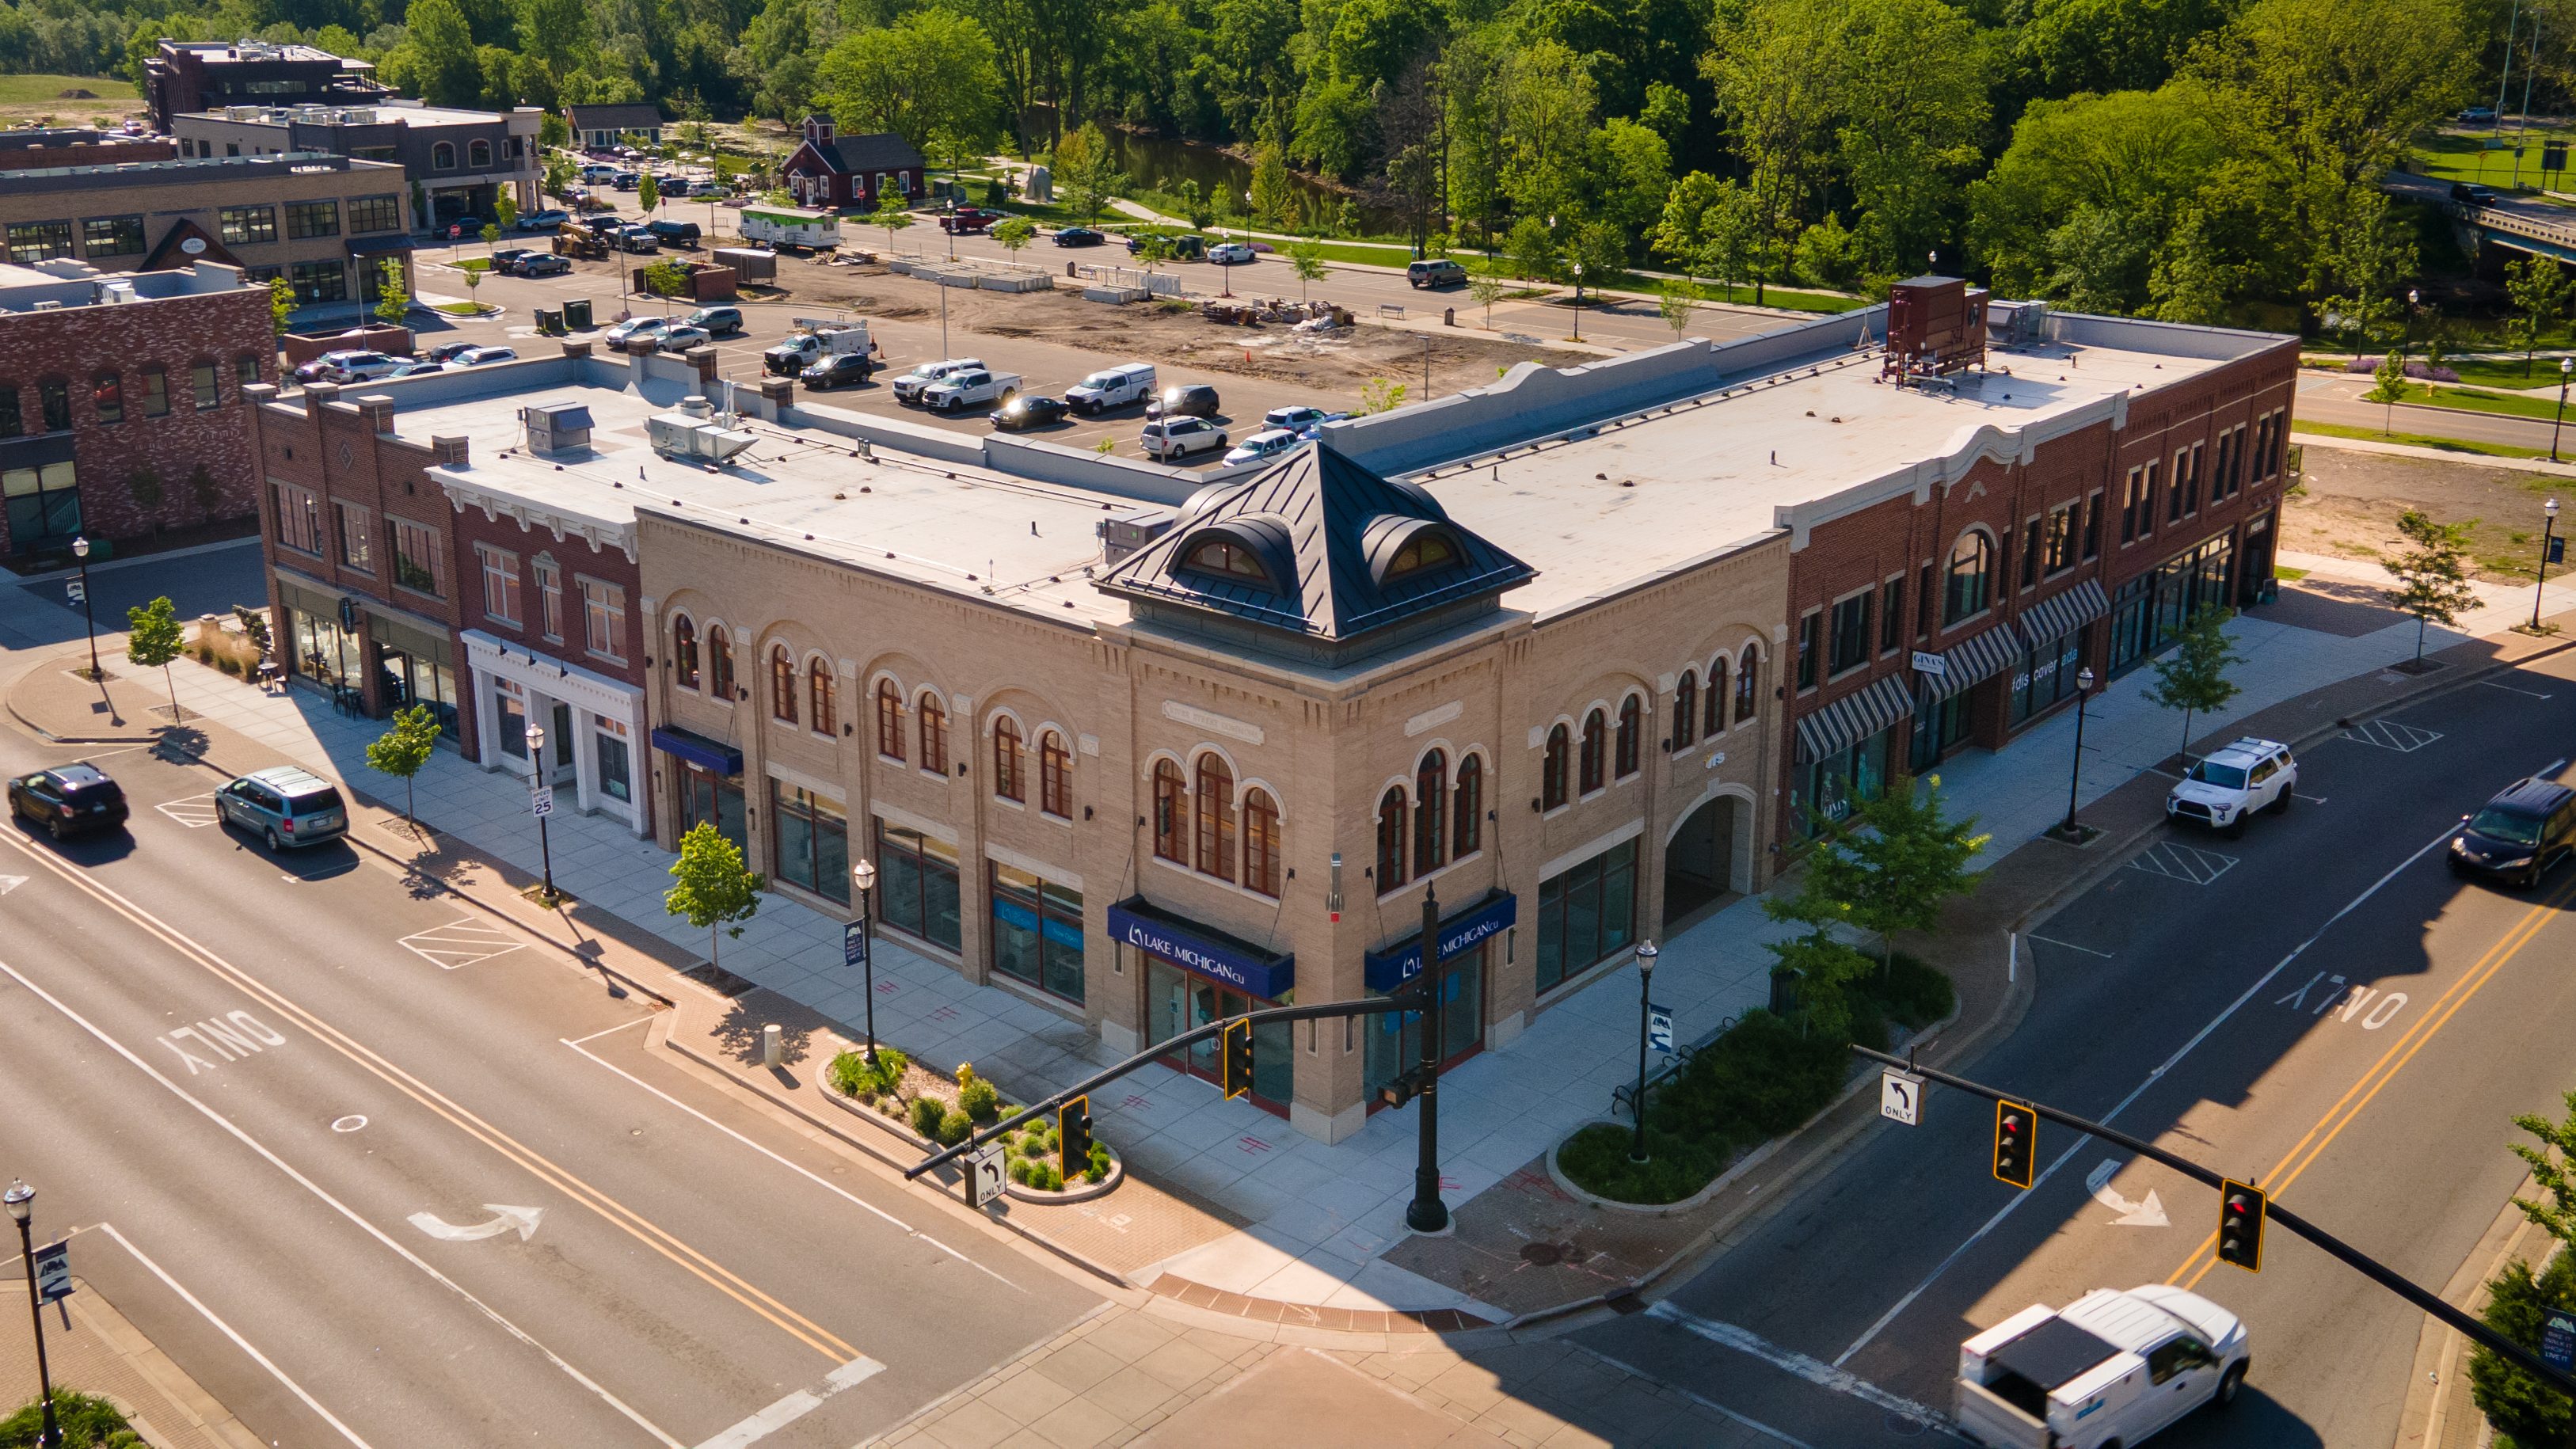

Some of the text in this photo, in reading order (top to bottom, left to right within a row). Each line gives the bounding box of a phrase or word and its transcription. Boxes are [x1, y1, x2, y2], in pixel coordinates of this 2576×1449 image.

[1913, 654, 1943, 665] GINA'S
[2061, 646, 2078, 667] ada
[535, 801, 551, 815] 25
[1144, 934, 1172, 955] LAKE
[2274, 971, 2408, 1029] ONLY
[156, 1010, 286, 1075] ONLY
[1885, 1105, 1912, 1121] ONLY
[980, 1183, 1003, 1202] ONLY
